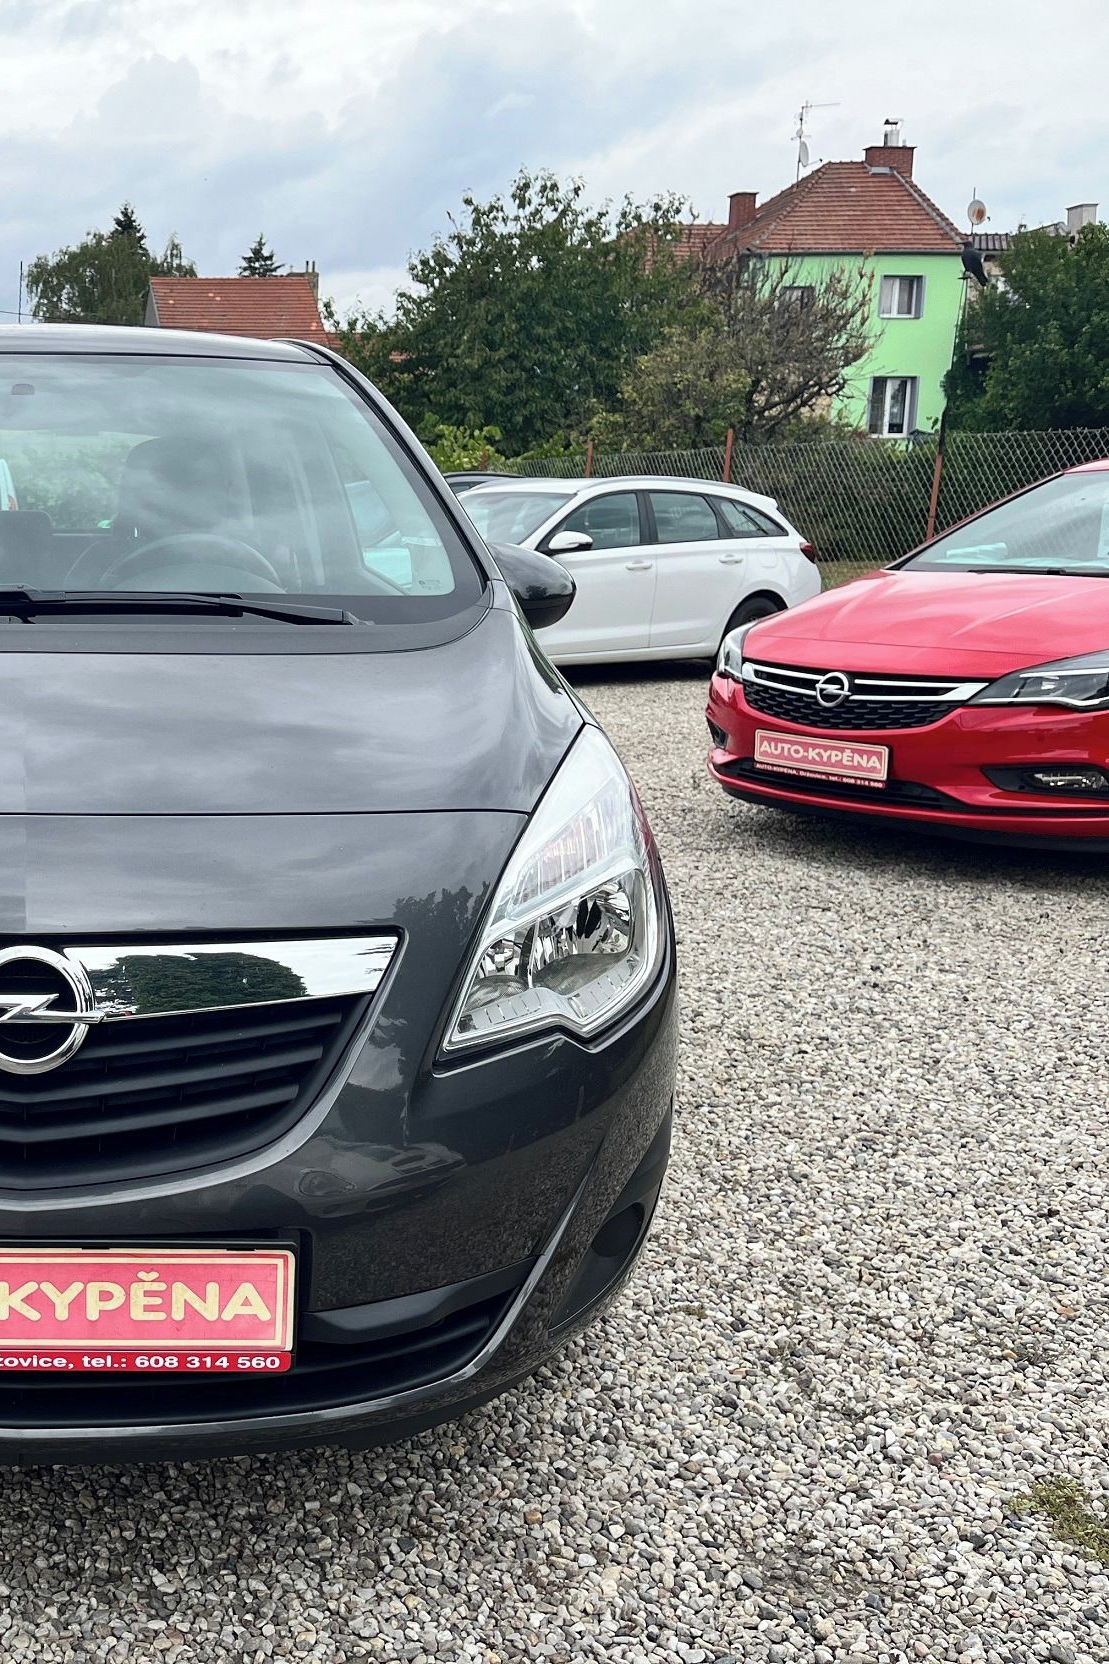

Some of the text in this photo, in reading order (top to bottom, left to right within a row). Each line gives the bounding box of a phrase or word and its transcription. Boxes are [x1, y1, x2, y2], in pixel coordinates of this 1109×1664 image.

[760, 740, 882, 769] AUTO-KYPĚNA
[82, 1355, 127, 1368] tel.:
[135, 1356, 179, 1368] 608
[186, 1356, 230, 1369] 314
[237, 1356, 281, 1369] 560
